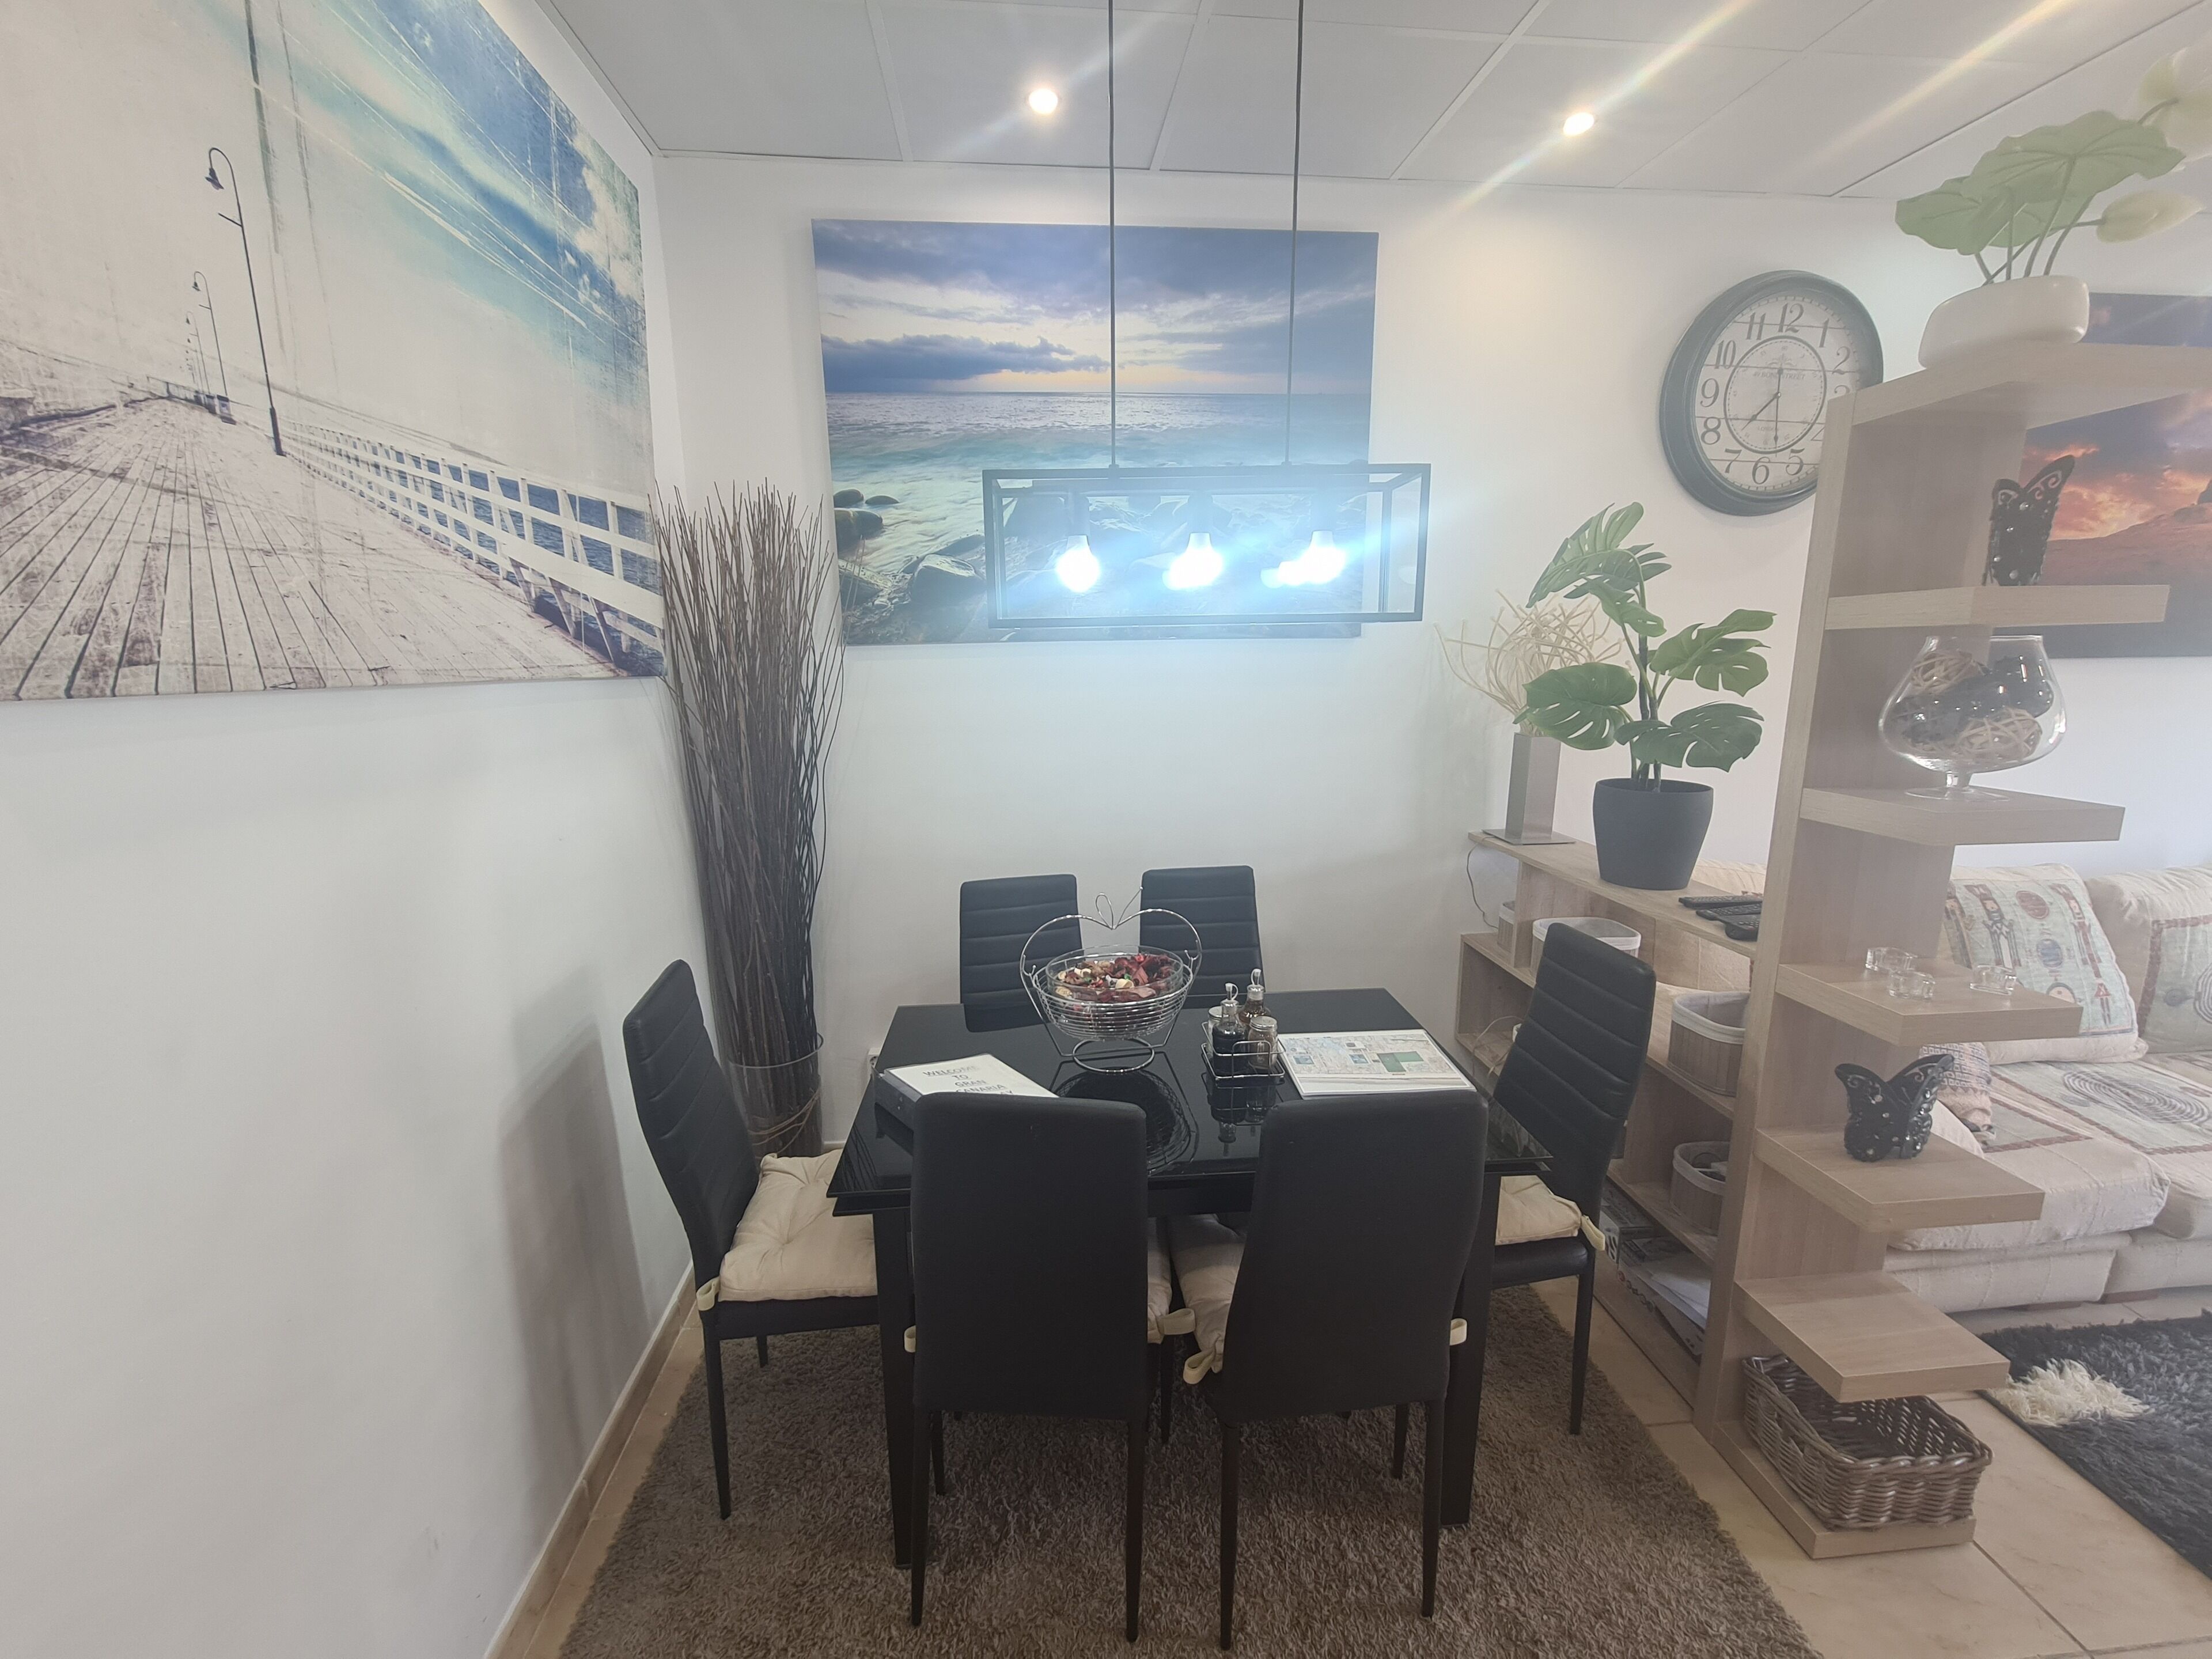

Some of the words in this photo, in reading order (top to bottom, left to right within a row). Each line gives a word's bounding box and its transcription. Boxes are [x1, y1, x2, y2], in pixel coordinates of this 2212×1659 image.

[1746, 312, 1766, 340] 11
[1778, 303, 1804, 333] 12
[1819, 318, 1830, 348] 1
[1714, 340, 1736, 369] 10
[1832, 346, 1851, 375] 2
[1700, 378, 1719, 407] 9
[1700, 416, 1721, 445] 8
[1724, 448, 1743, 474] 7
[1752, 456, 1770, 484] 6
[1786, 448, 1805, 476] 5
[956, 1084, 1006, 1093] CANARIA
